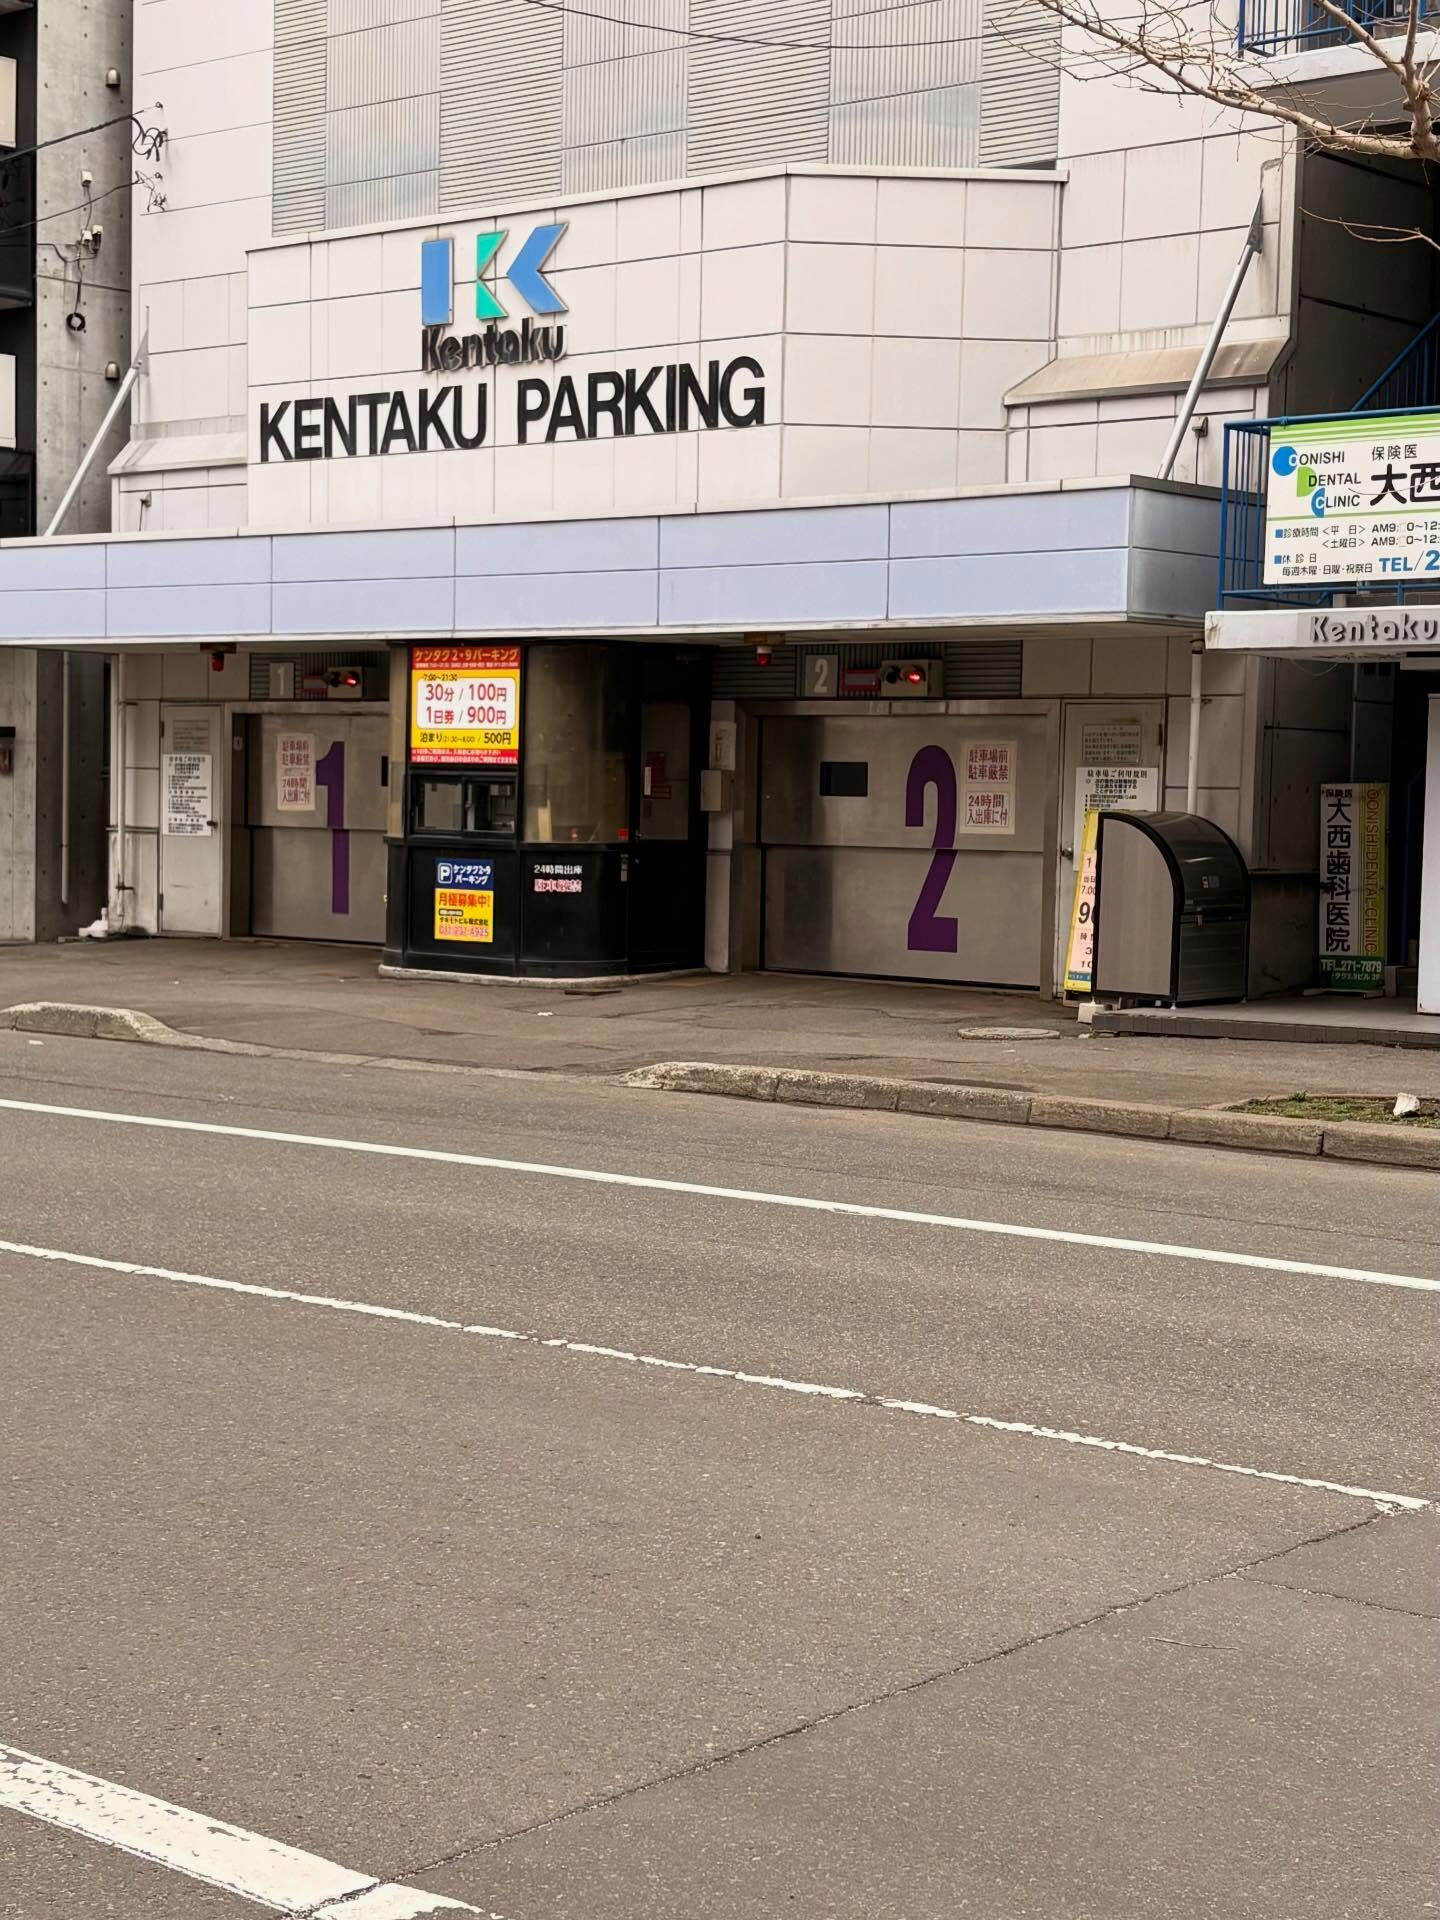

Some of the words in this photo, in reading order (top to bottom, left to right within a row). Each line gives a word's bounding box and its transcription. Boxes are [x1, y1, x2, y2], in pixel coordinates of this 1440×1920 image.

[421, 317, 568, 373] Kentaku
[260, 383, 487, 462] KENTAKU
[517, 355, 766, 444] PARKING
[1371, 444, 1418, 461] 保険医
[1308, 472, 1362, 487] DENTAL
[1315, 494, 1361, 509] CLINIC
[1310, 613, 1438, 643] Kentaku
[276, 666, 285, 697] 1
[814, 658, 828, 693] 2
[425, 683, 454, 702] 30分
[468, 683, 507, 702] 100円
[426, 706, 454, 725] 1日券
[467, 706, 507, 725] 900円
[484, 732, 511, 745] 500円
[968, 748, 1009, 763] 駐車場前
[967, 764, 1009, 780] 駐車厳禁
[968, 793, 1005, 808] 24時間
[967, 809, 1008, 825] 入出庫に付
[316, 740, 350, 915] 1
[905, 744, 958, 953] 2
[534, 864, 583, 875] 24時間出庫
[1326, 798, 1352, 953] 大西歯科医院
[455, 875, 488, 885] パーキング
